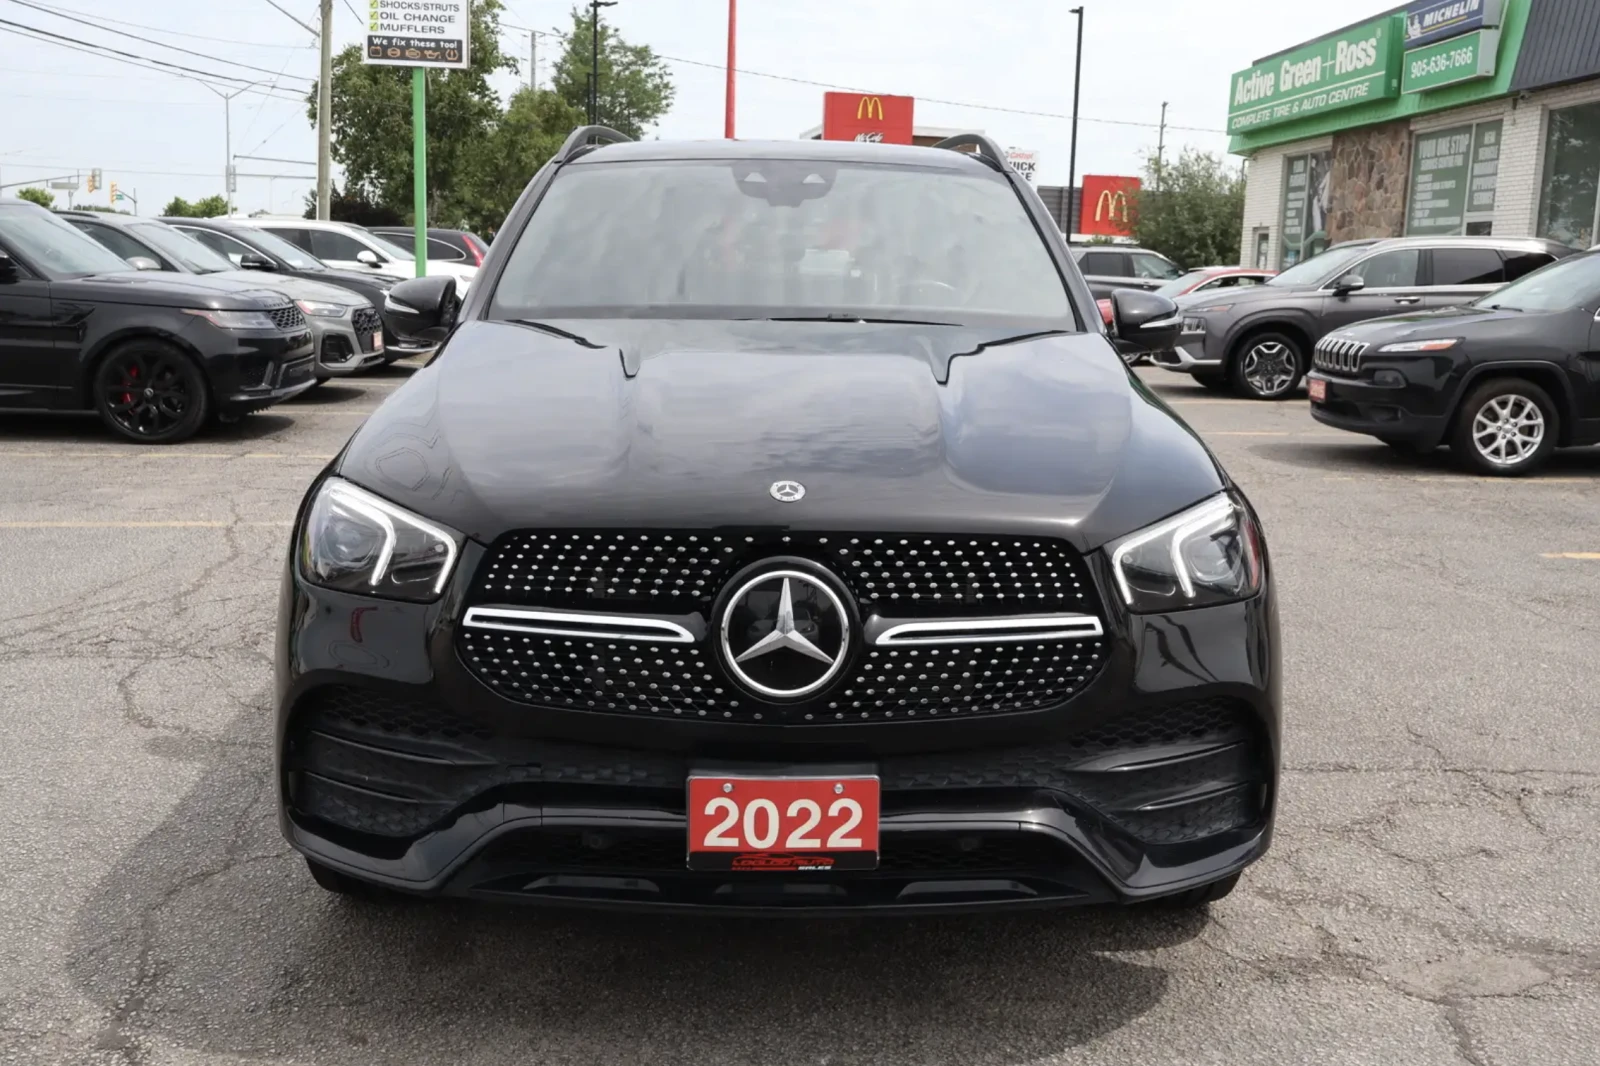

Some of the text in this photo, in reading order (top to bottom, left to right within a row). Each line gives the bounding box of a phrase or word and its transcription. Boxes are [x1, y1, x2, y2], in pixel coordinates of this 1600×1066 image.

[380, 0, 460, 12] SHOCKS/STRUTS
[380, 12, 456, 23] OIL CHANGE
[1423, 0, 1480, 27] MICHELIN
[380, 24, 445, 34] MUFFLERS
[372, 37, 457, 49] We fix these too!
[1411, 46, 1473, 79] 905-636-7666
[1234, 70, 1275, 106] Active
[1231, 109, 1271, 129] COMPLETE
[1273, 104, 1292, 117] TIRE
[1300, 95, 1327, 112] AUTO
[1328, 82, 1370, 105] CENTRE
[703, 797, 863, 849] 2022
